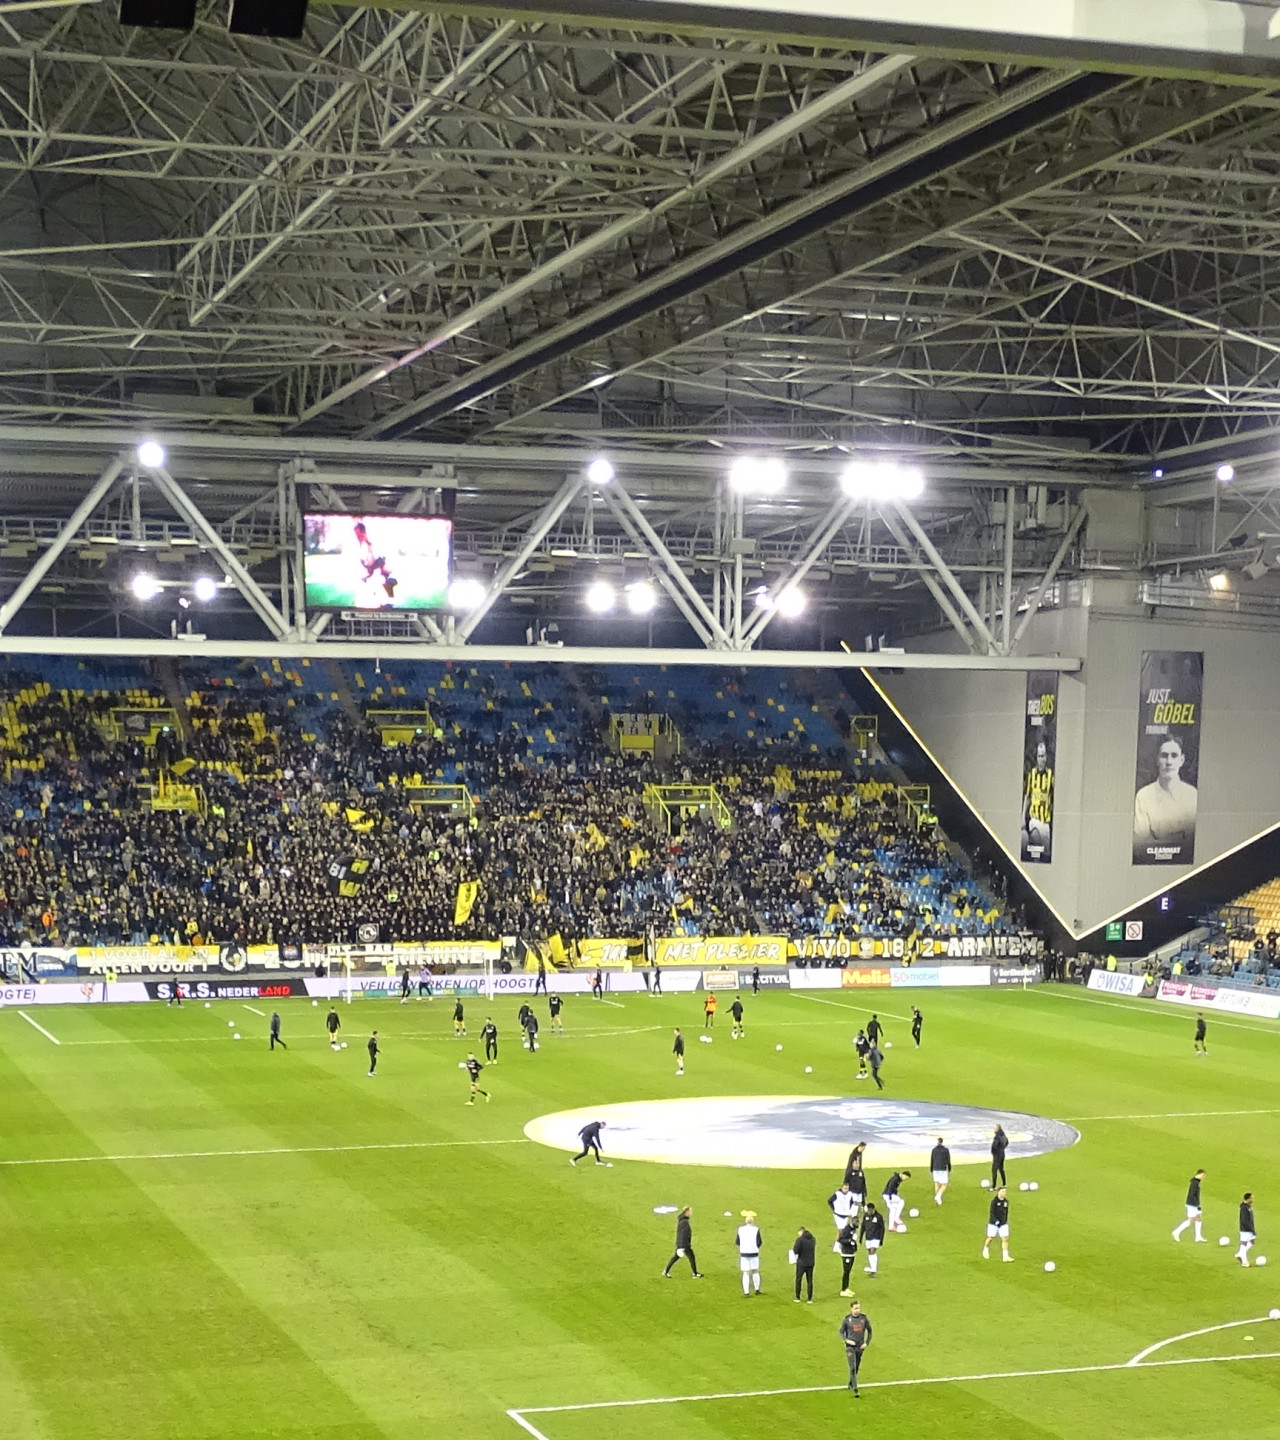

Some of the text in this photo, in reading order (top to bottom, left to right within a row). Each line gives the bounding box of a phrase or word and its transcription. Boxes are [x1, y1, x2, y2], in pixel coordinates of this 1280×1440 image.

[1040, 693, 1055, 715] BOS
[1146, 688, 1171, 704] JUST
[1153, 699, 1195, 724] GÖBEL
[1161, 896, 1169, 910] E
[663, 941, 705, 961] MET
[705, 941, 780, 961] PLEZIER
[793, 938, 851, 959] VIVO
[947, 936, 1037, 957] ARNHEM
[145, 962, 198, 974] VOOR
[842, 969, 890, 985] Melis
[1106, 975, 1134, 992] WISA
[218, 985, 292, 998] NEDERLAND
